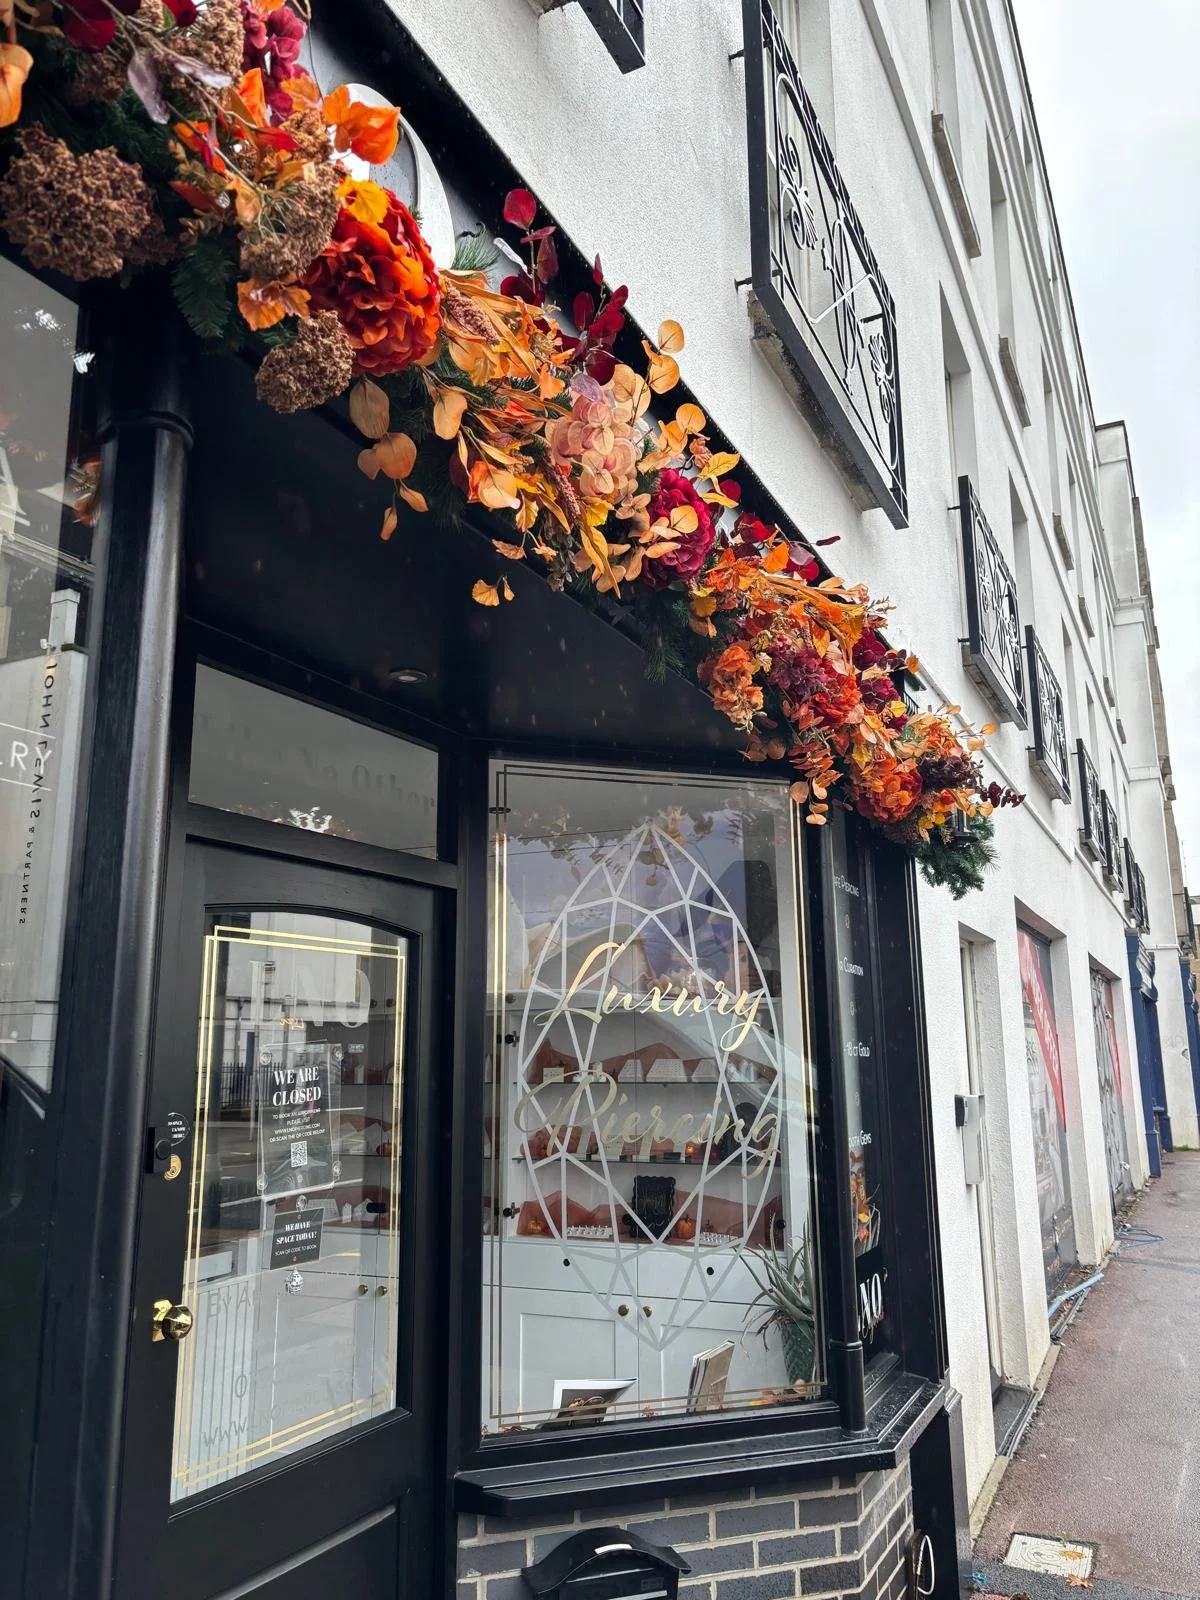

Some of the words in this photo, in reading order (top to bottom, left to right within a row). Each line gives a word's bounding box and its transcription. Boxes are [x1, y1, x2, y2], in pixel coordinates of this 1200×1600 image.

[0, 741, 52, 774] RY
[533, 941, 767, 1051] Luxury
[274, 1069, 295, 1086] WE
[299, 1066, 320, 1083] ARE
[272, 1086, 322, 1107] CLOSED
[514, 1069, 782, 1180] Piercing
[276, 1234, 295, 1245] SPACE
[858, 1272, 882, 1330] NO
